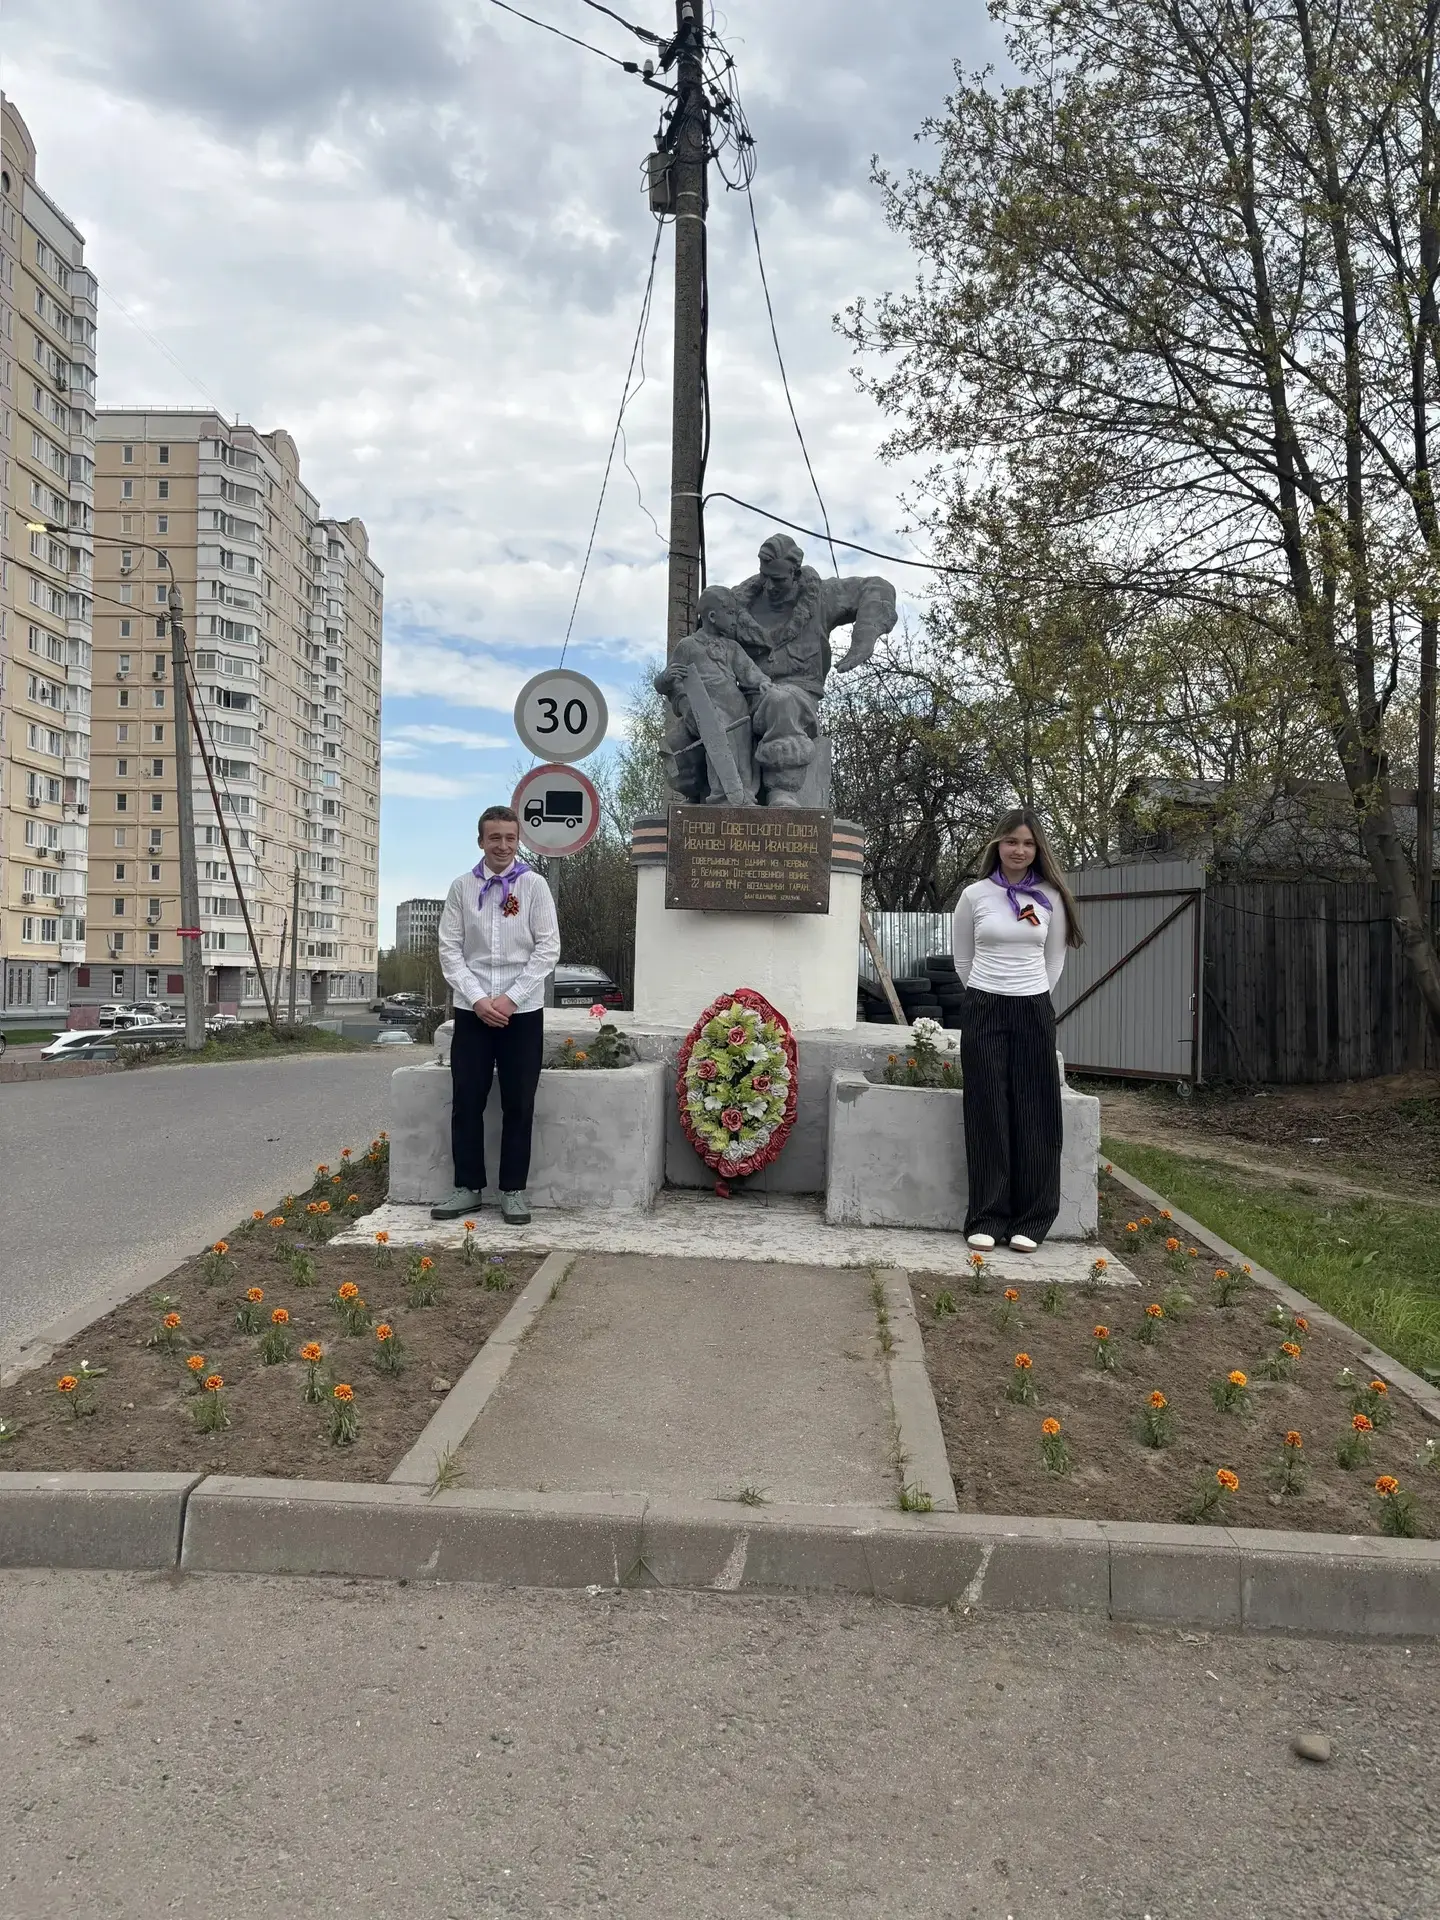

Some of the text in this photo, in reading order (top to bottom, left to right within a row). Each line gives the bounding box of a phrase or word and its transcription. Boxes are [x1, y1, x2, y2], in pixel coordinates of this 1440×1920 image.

[537, 698, 588, 735] 30
[684, 836, 726, 850] ИВАНОВУ
[730, 838, 760, 852] ИВАНУ
[691, 878, 700, 888] 22
